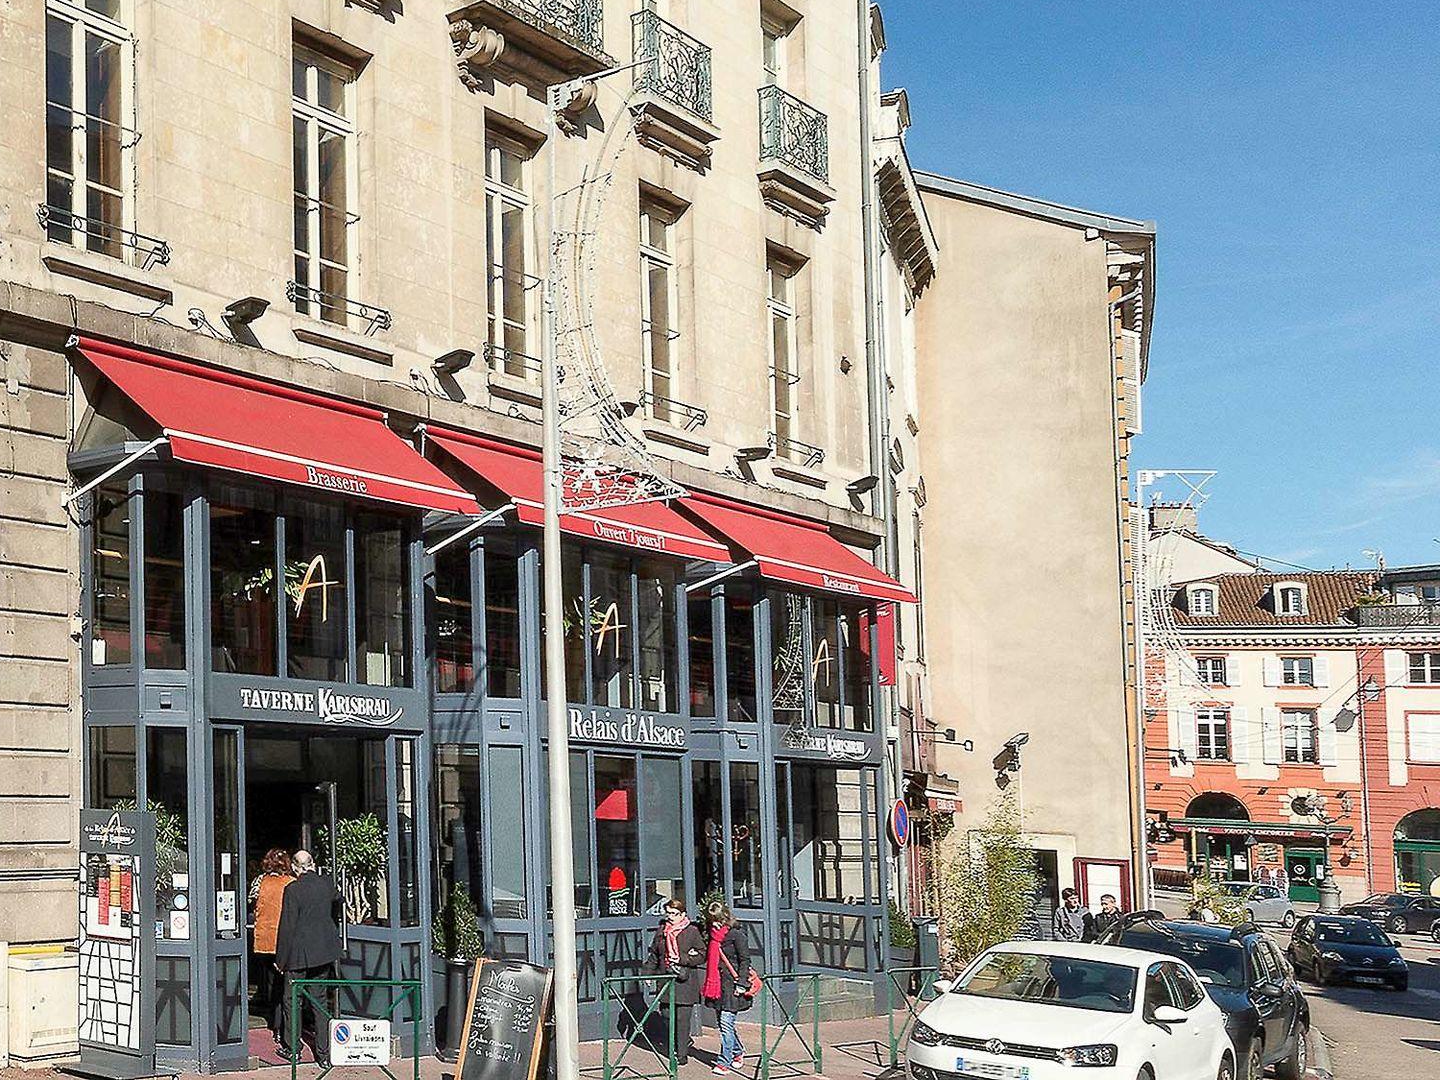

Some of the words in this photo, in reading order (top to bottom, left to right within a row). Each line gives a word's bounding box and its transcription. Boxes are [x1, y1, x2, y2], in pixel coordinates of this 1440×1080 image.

[306, 465, 367, 493] Brasserie
[593, 521, 627, 541] Ouvert
[240, 688, 314, 712] TAVERNE
[318, 688, 391, 719] KARLSBRAU
[569, 709, 618, 740] Relais
[622, 713, 685, 745] d'Alsace
